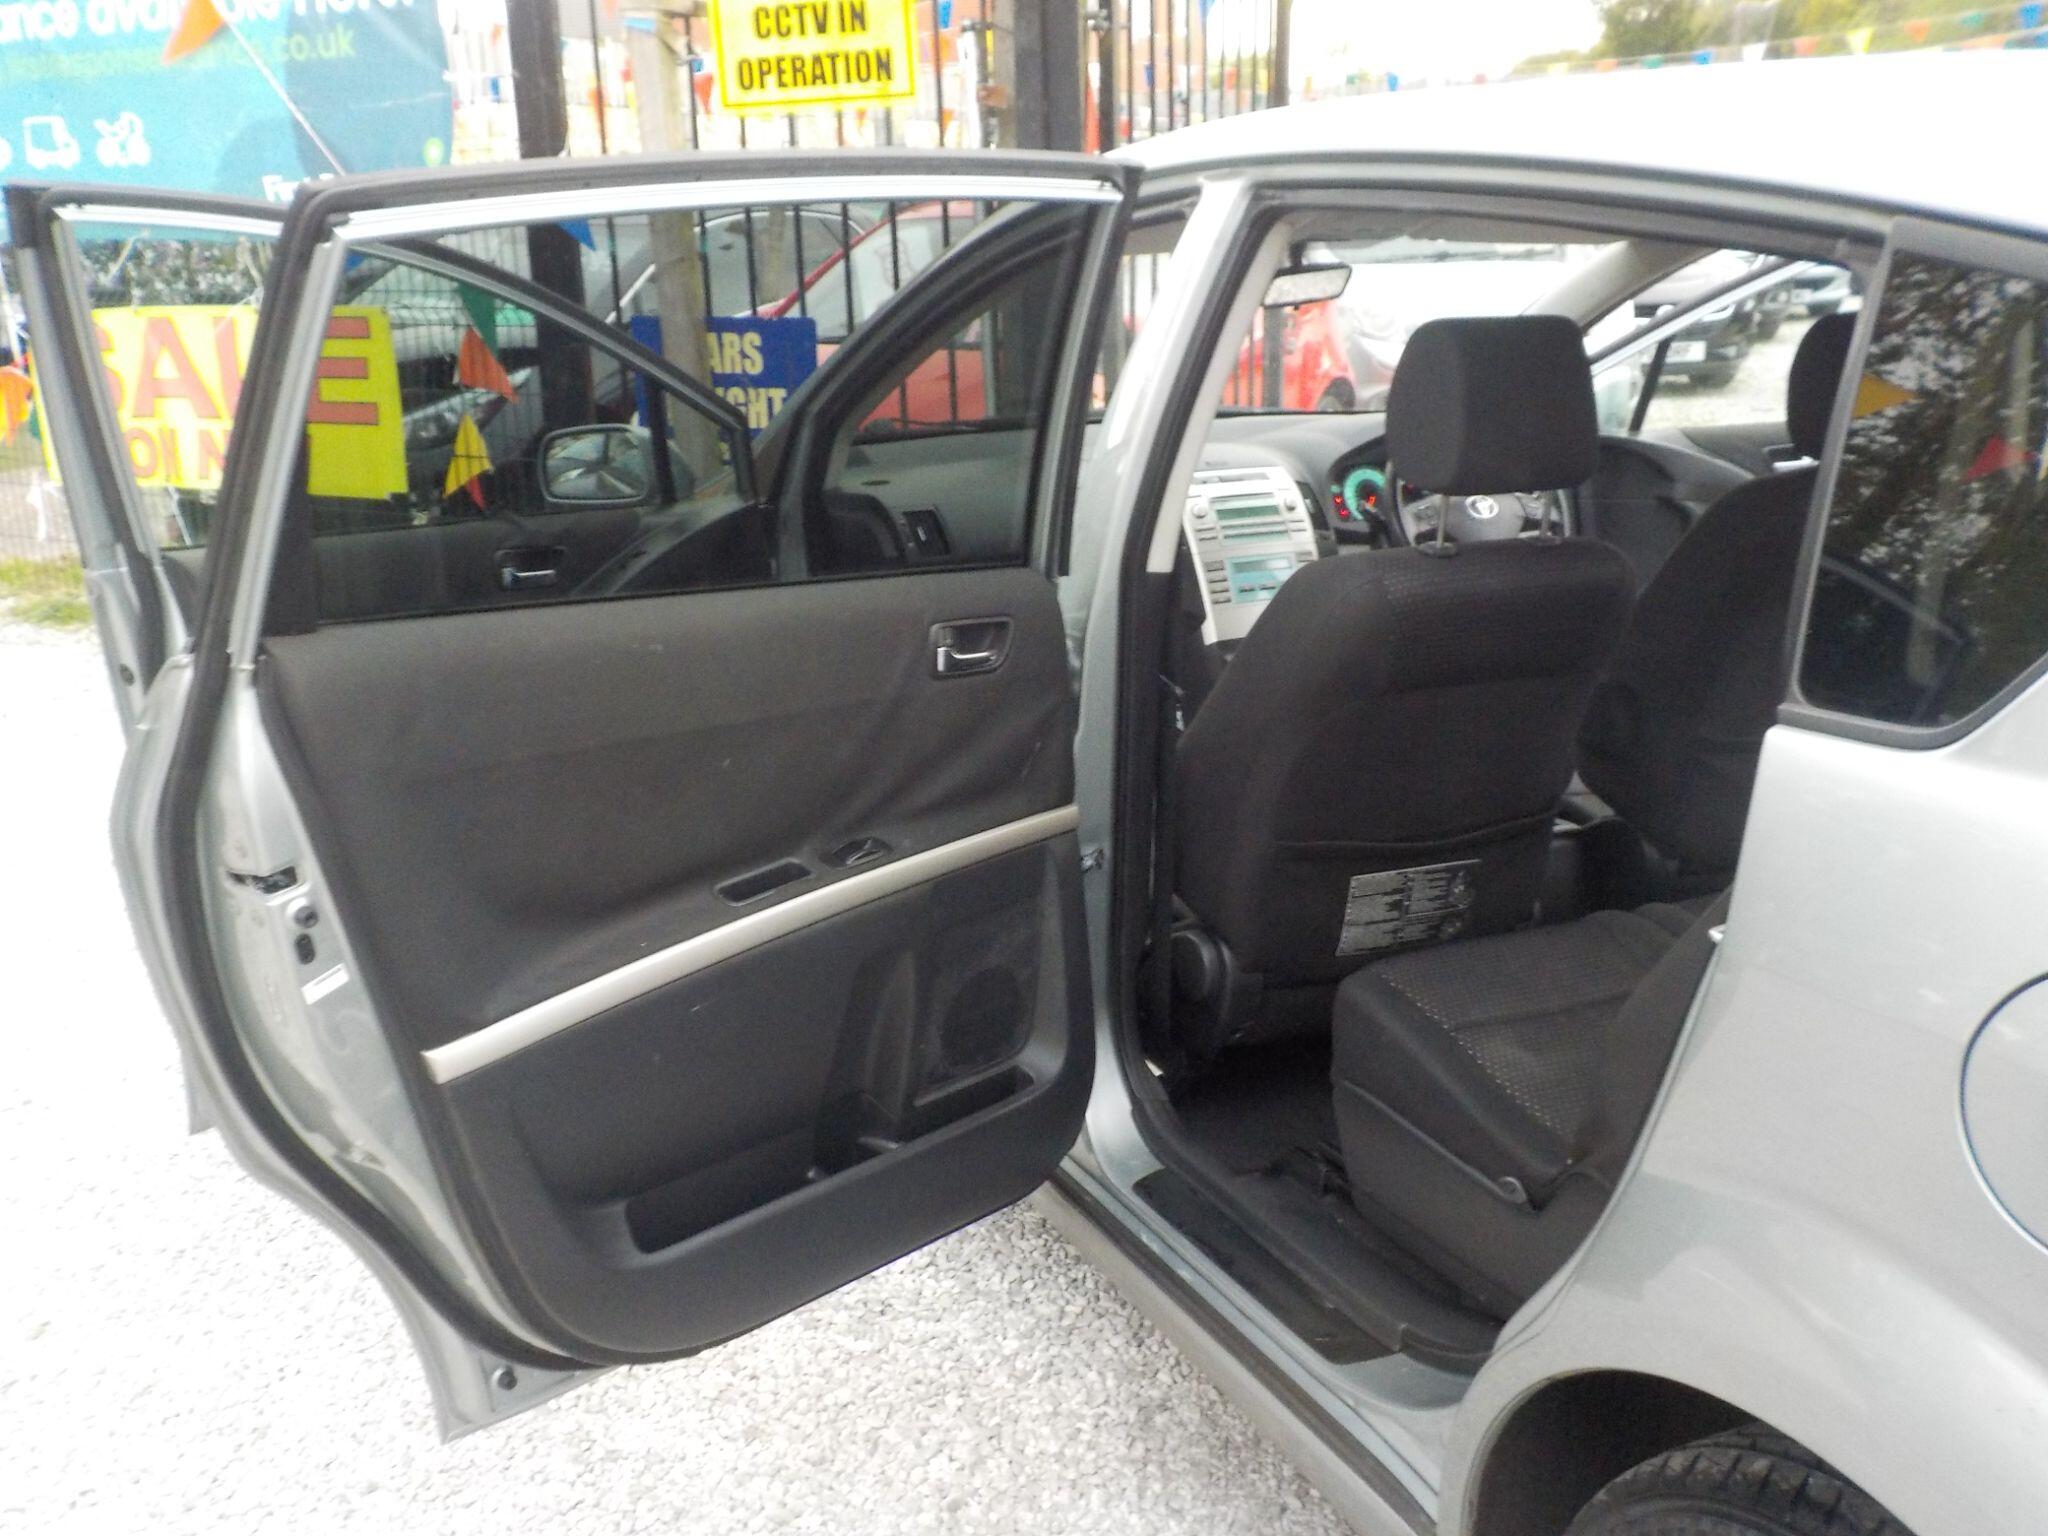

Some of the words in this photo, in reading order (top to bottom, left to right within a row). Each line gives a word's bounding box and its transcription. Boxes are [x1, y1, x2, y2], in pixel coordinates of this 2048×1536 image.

[754, 3, 828, 39] CCTV
[838, 0, 867, 32] IN
[738, 48, 893, 91] OPERATION
[707, 331, 764, 375] ARS
